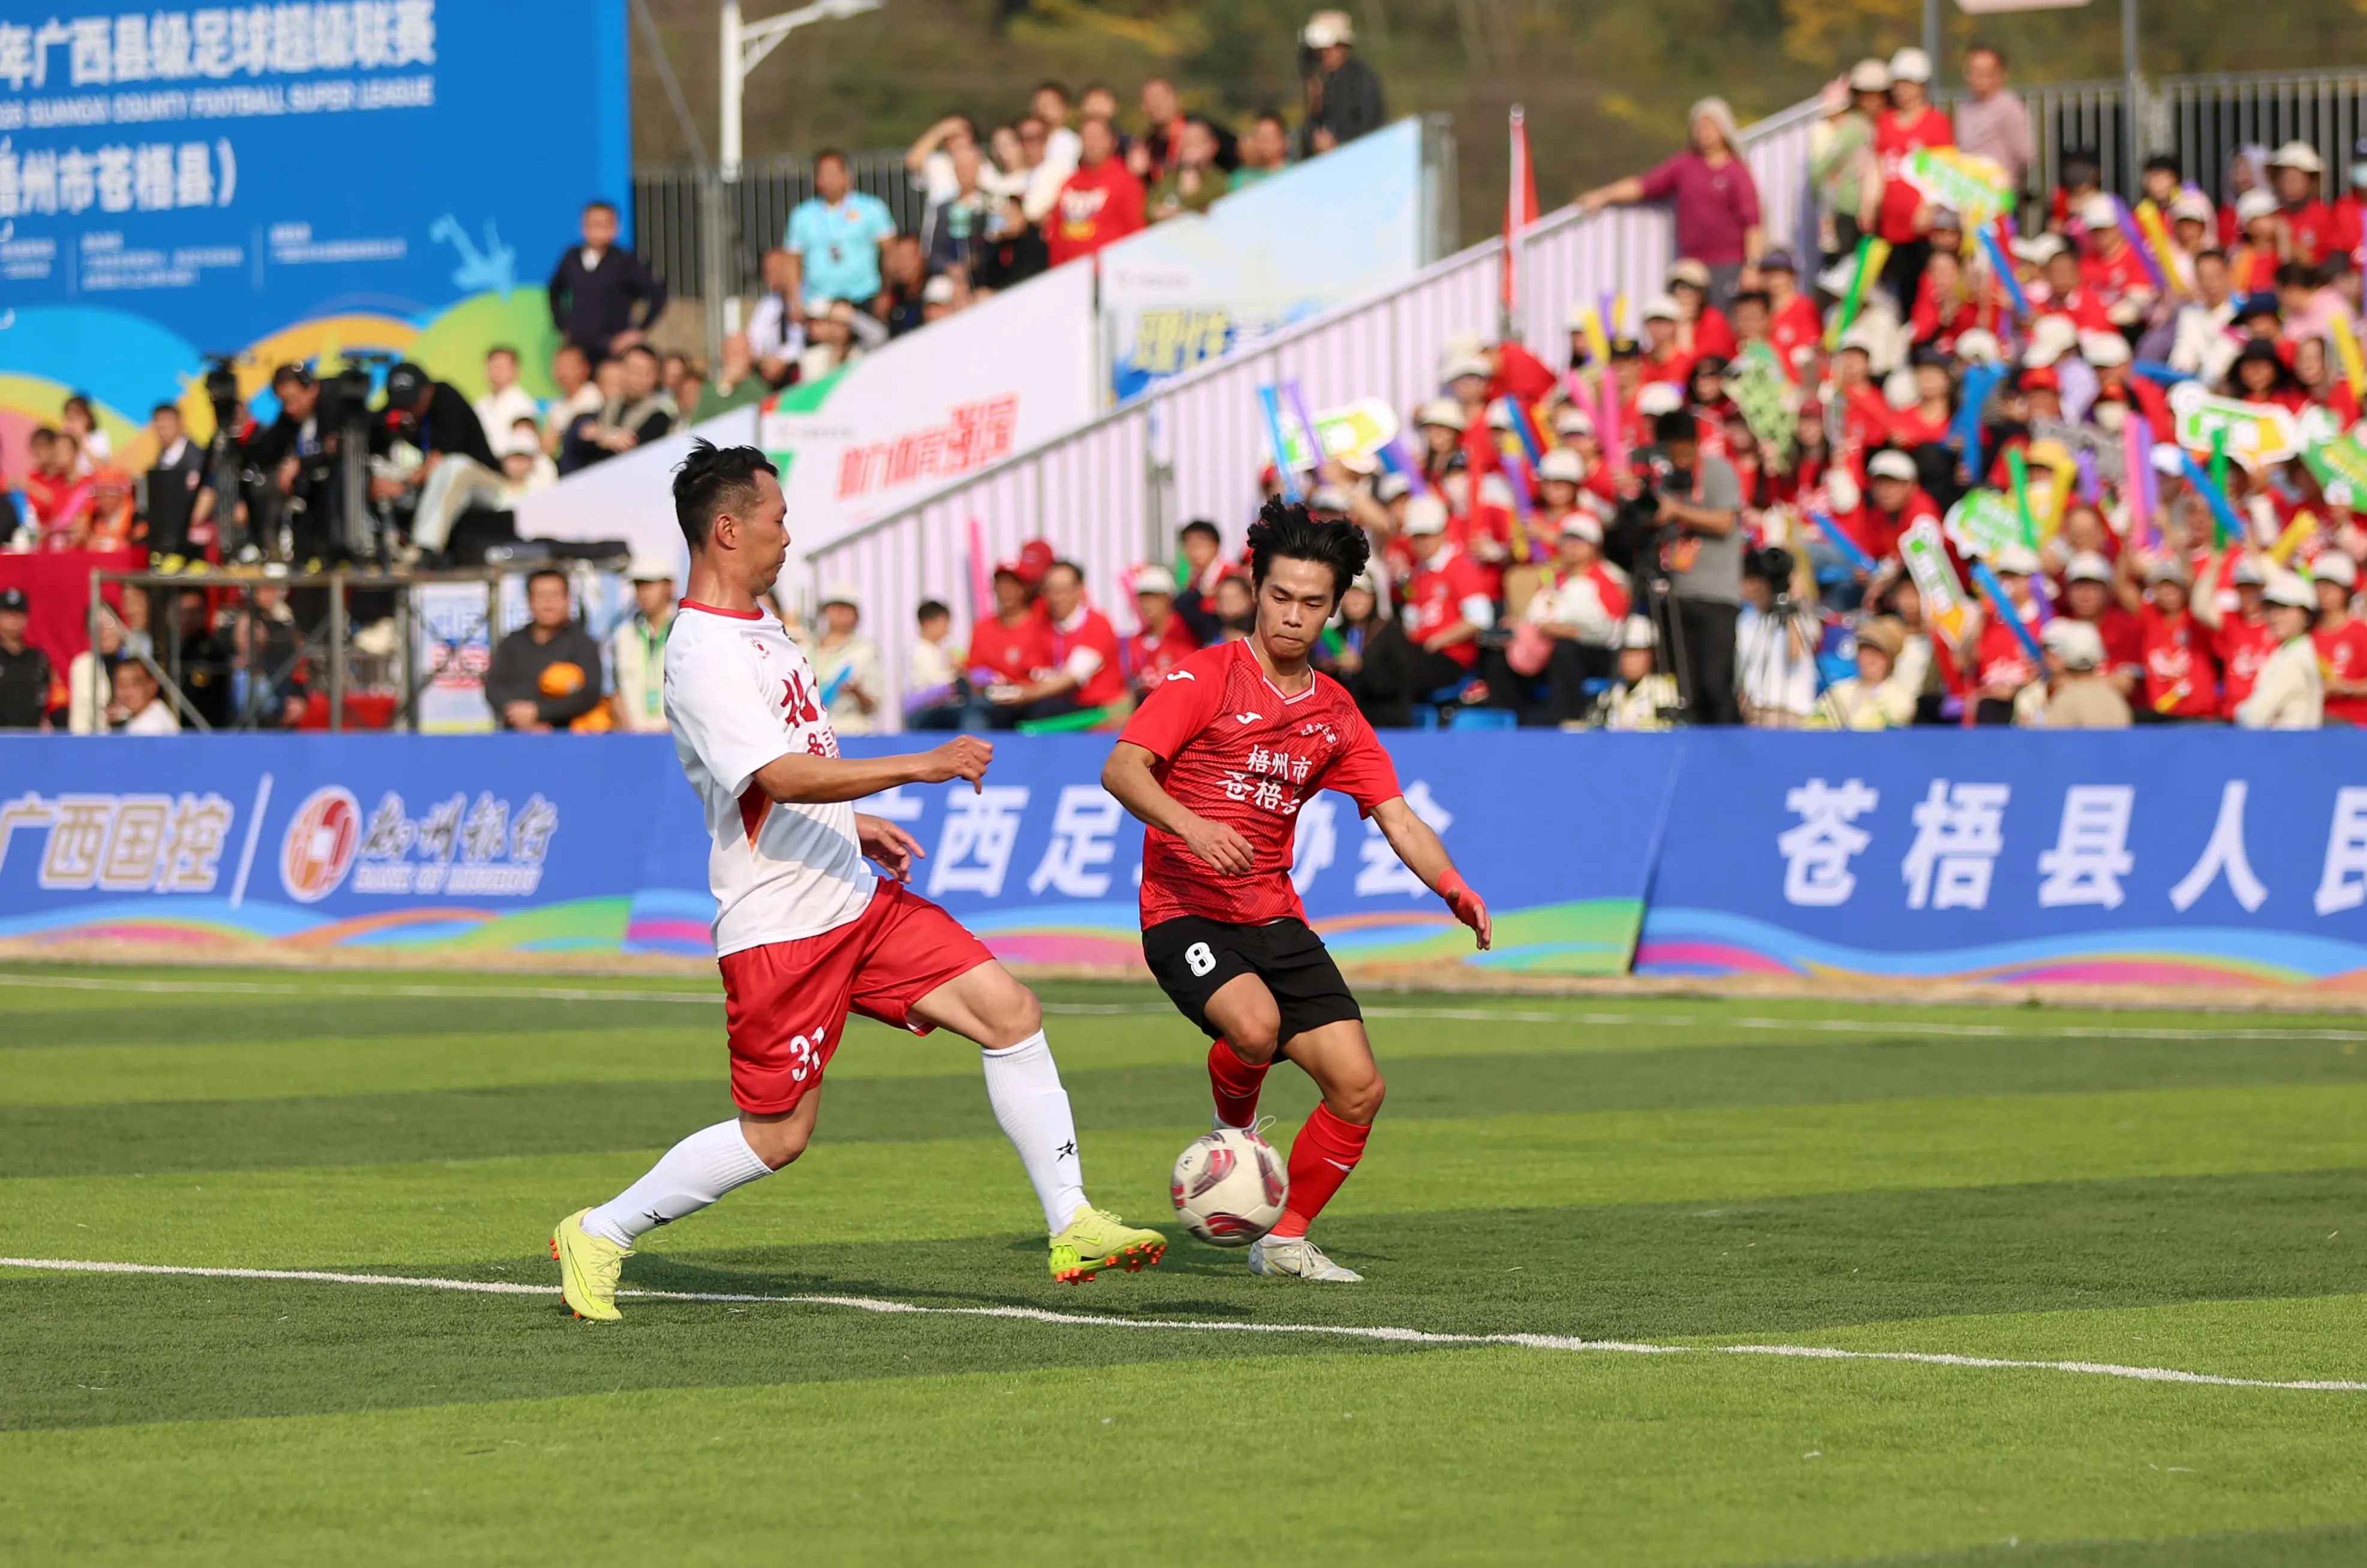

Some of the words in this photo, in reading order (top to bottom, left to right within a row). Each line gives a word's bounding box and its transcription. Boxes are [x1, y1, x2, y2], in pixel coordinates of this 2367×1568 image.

[1246, 744, 1313, 785] 梧州市
[0, 791, 234, 894] 广西国控
[1185, 942, 1216, 977] 8
